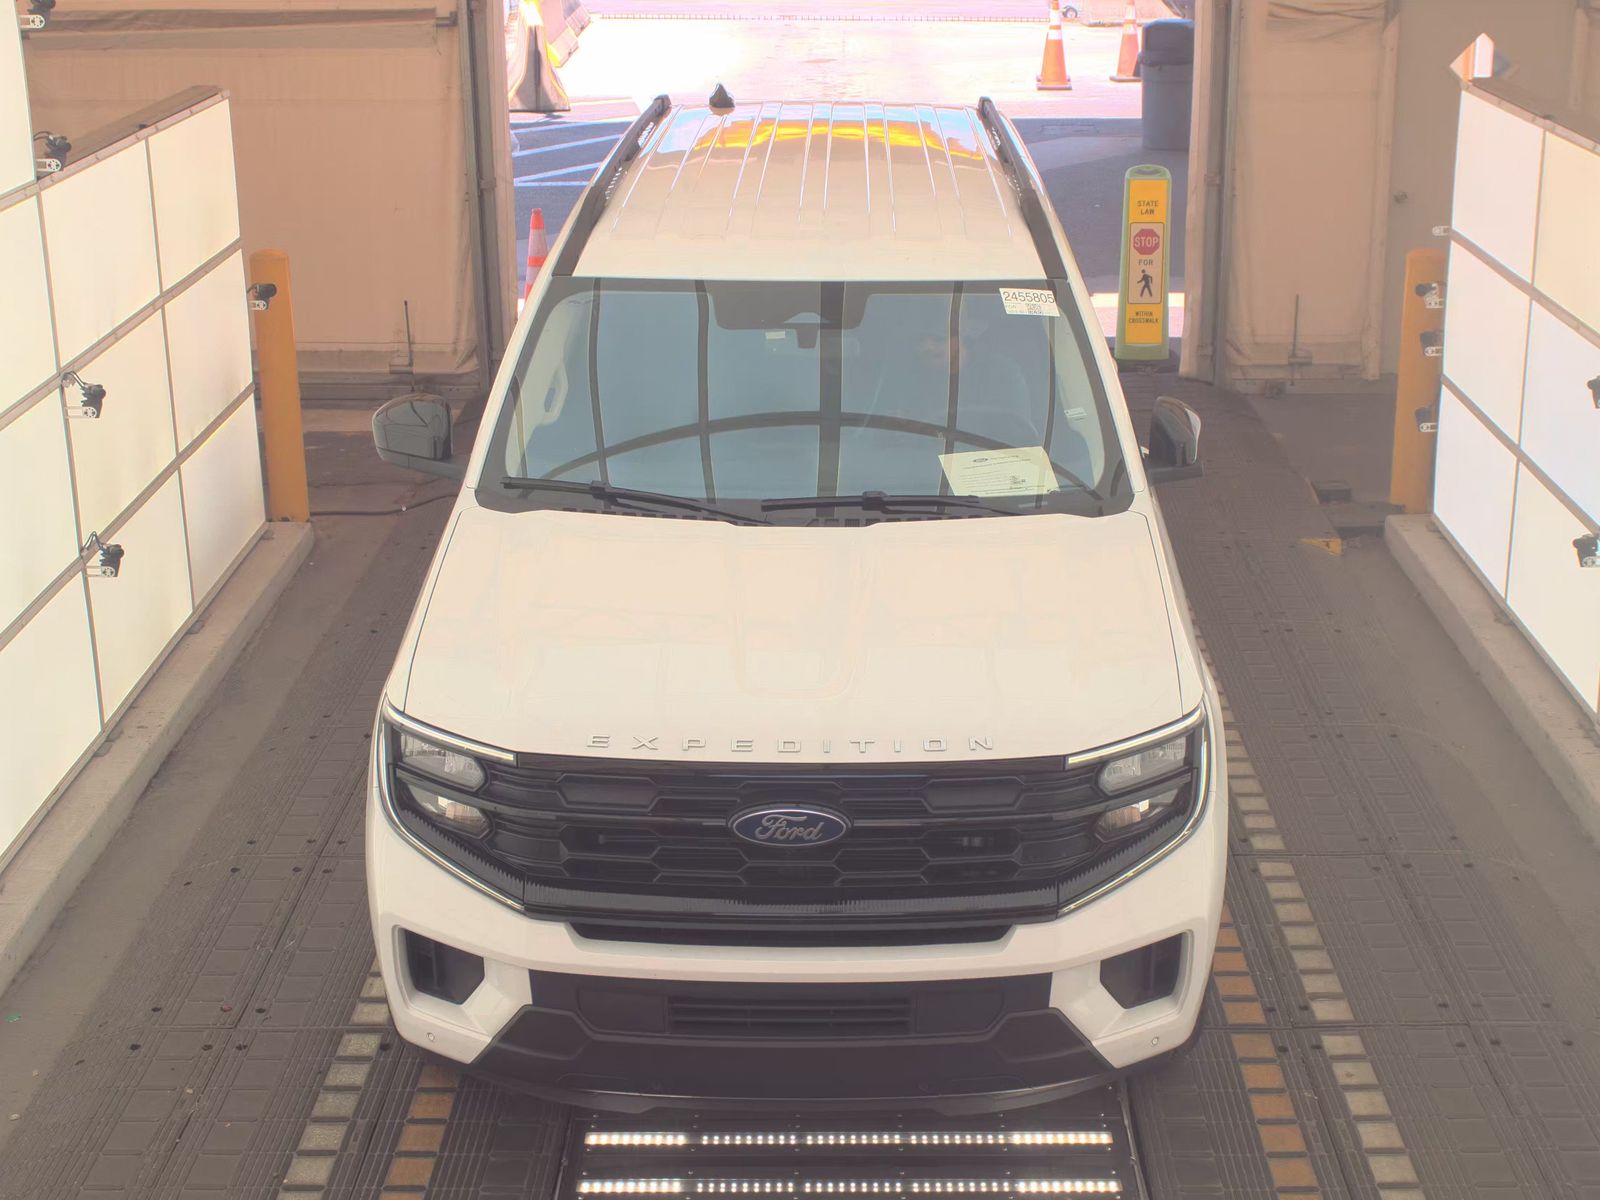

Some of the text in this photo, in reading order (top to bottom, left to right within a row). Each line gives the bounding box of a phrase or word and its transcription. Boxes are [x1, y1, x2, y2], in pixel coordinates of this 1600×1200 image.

[1134, 236, 1159, 248] STOP
[1003, 291, 1055, 303] 2455805
[586, 734, 993, 754] EXPEDITION
[754, 813, 825, 842] Ford
